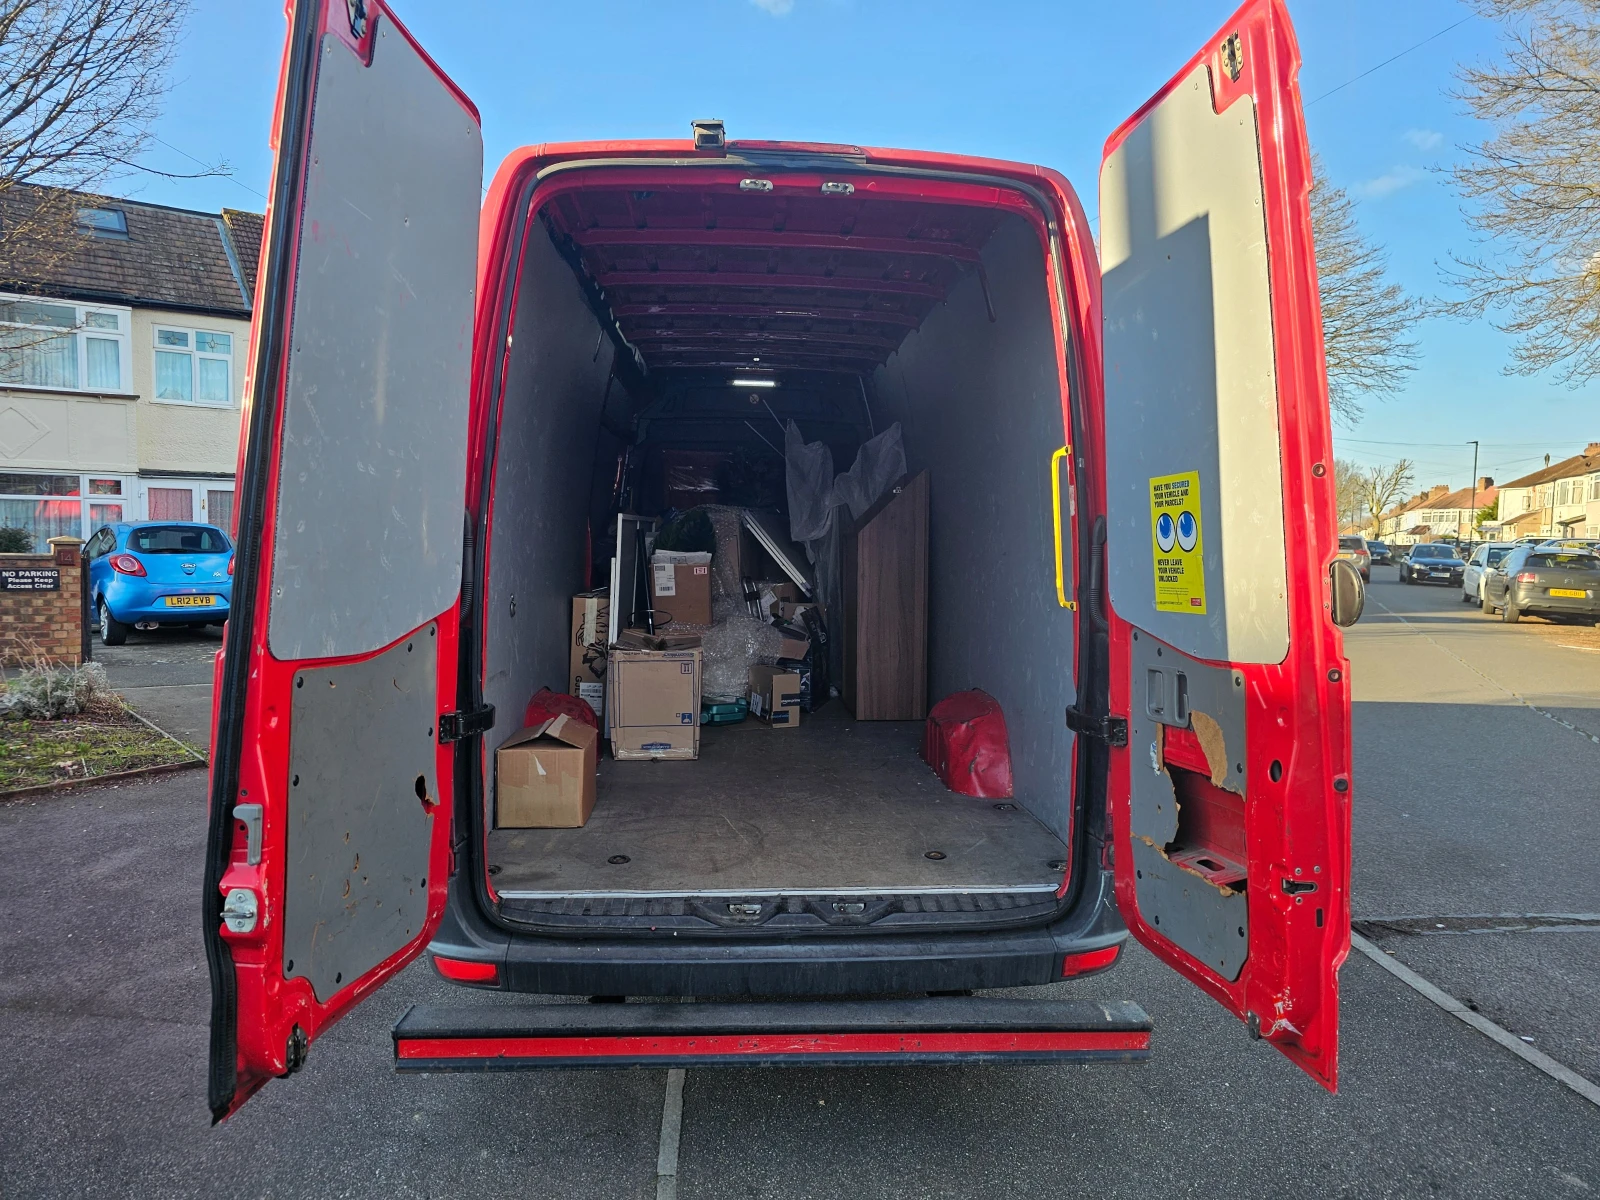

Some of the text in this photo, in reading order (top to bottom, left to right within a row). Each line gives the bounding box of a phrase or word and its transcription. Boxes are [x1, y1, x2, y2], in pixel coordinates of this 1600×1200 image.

[1172, 480, 1189, 489] SECURED
[1164, 490, 1180, 499] VEHICLE
[1165, 498, 1184, 507] PARCELS?
[60, 552, 72, 564] 14
